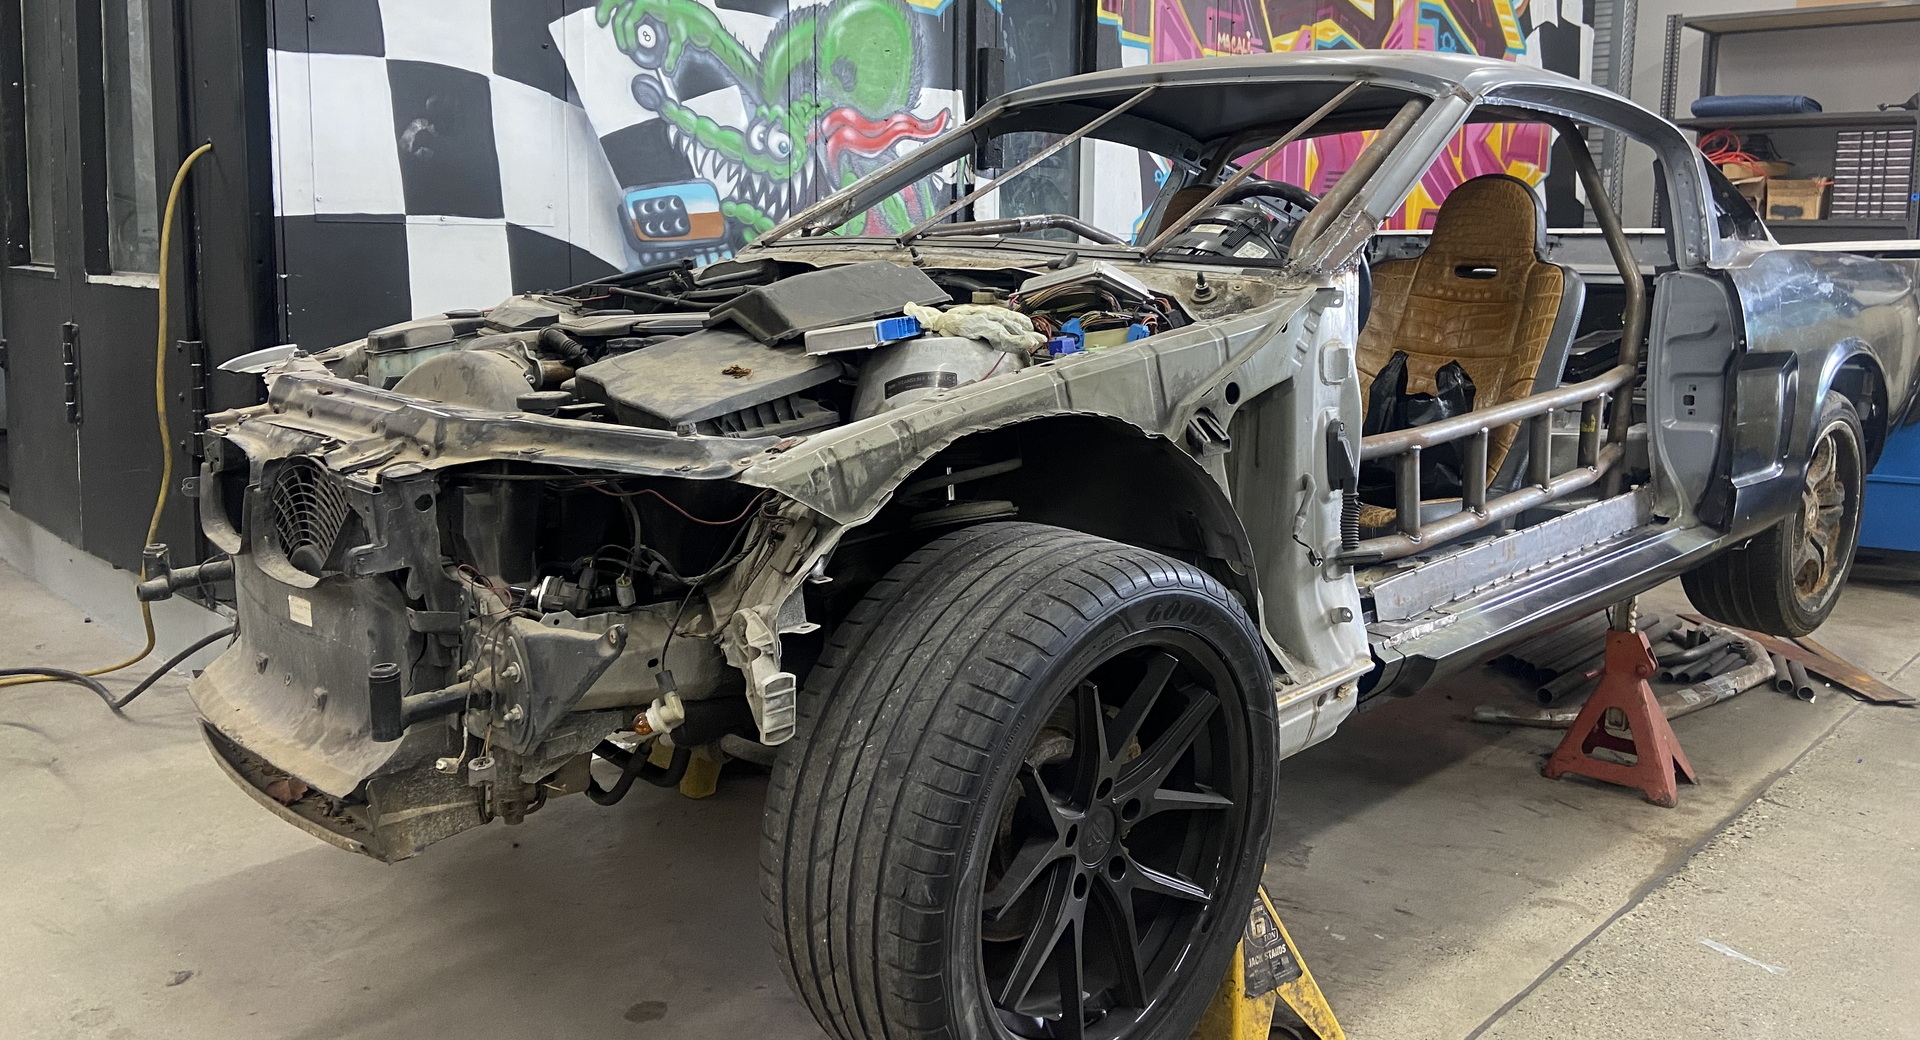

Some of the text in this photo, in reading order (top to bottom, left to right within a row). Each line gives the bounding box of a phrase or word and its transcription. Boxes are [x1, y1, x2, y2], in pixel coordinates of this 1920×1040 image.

[642, 31, 652, 42] 8
[1264, 931, 1276, 942] TON
[1248, 954, 1263, 968] JACK
[1264, 943, 1287, 960] STANDS
